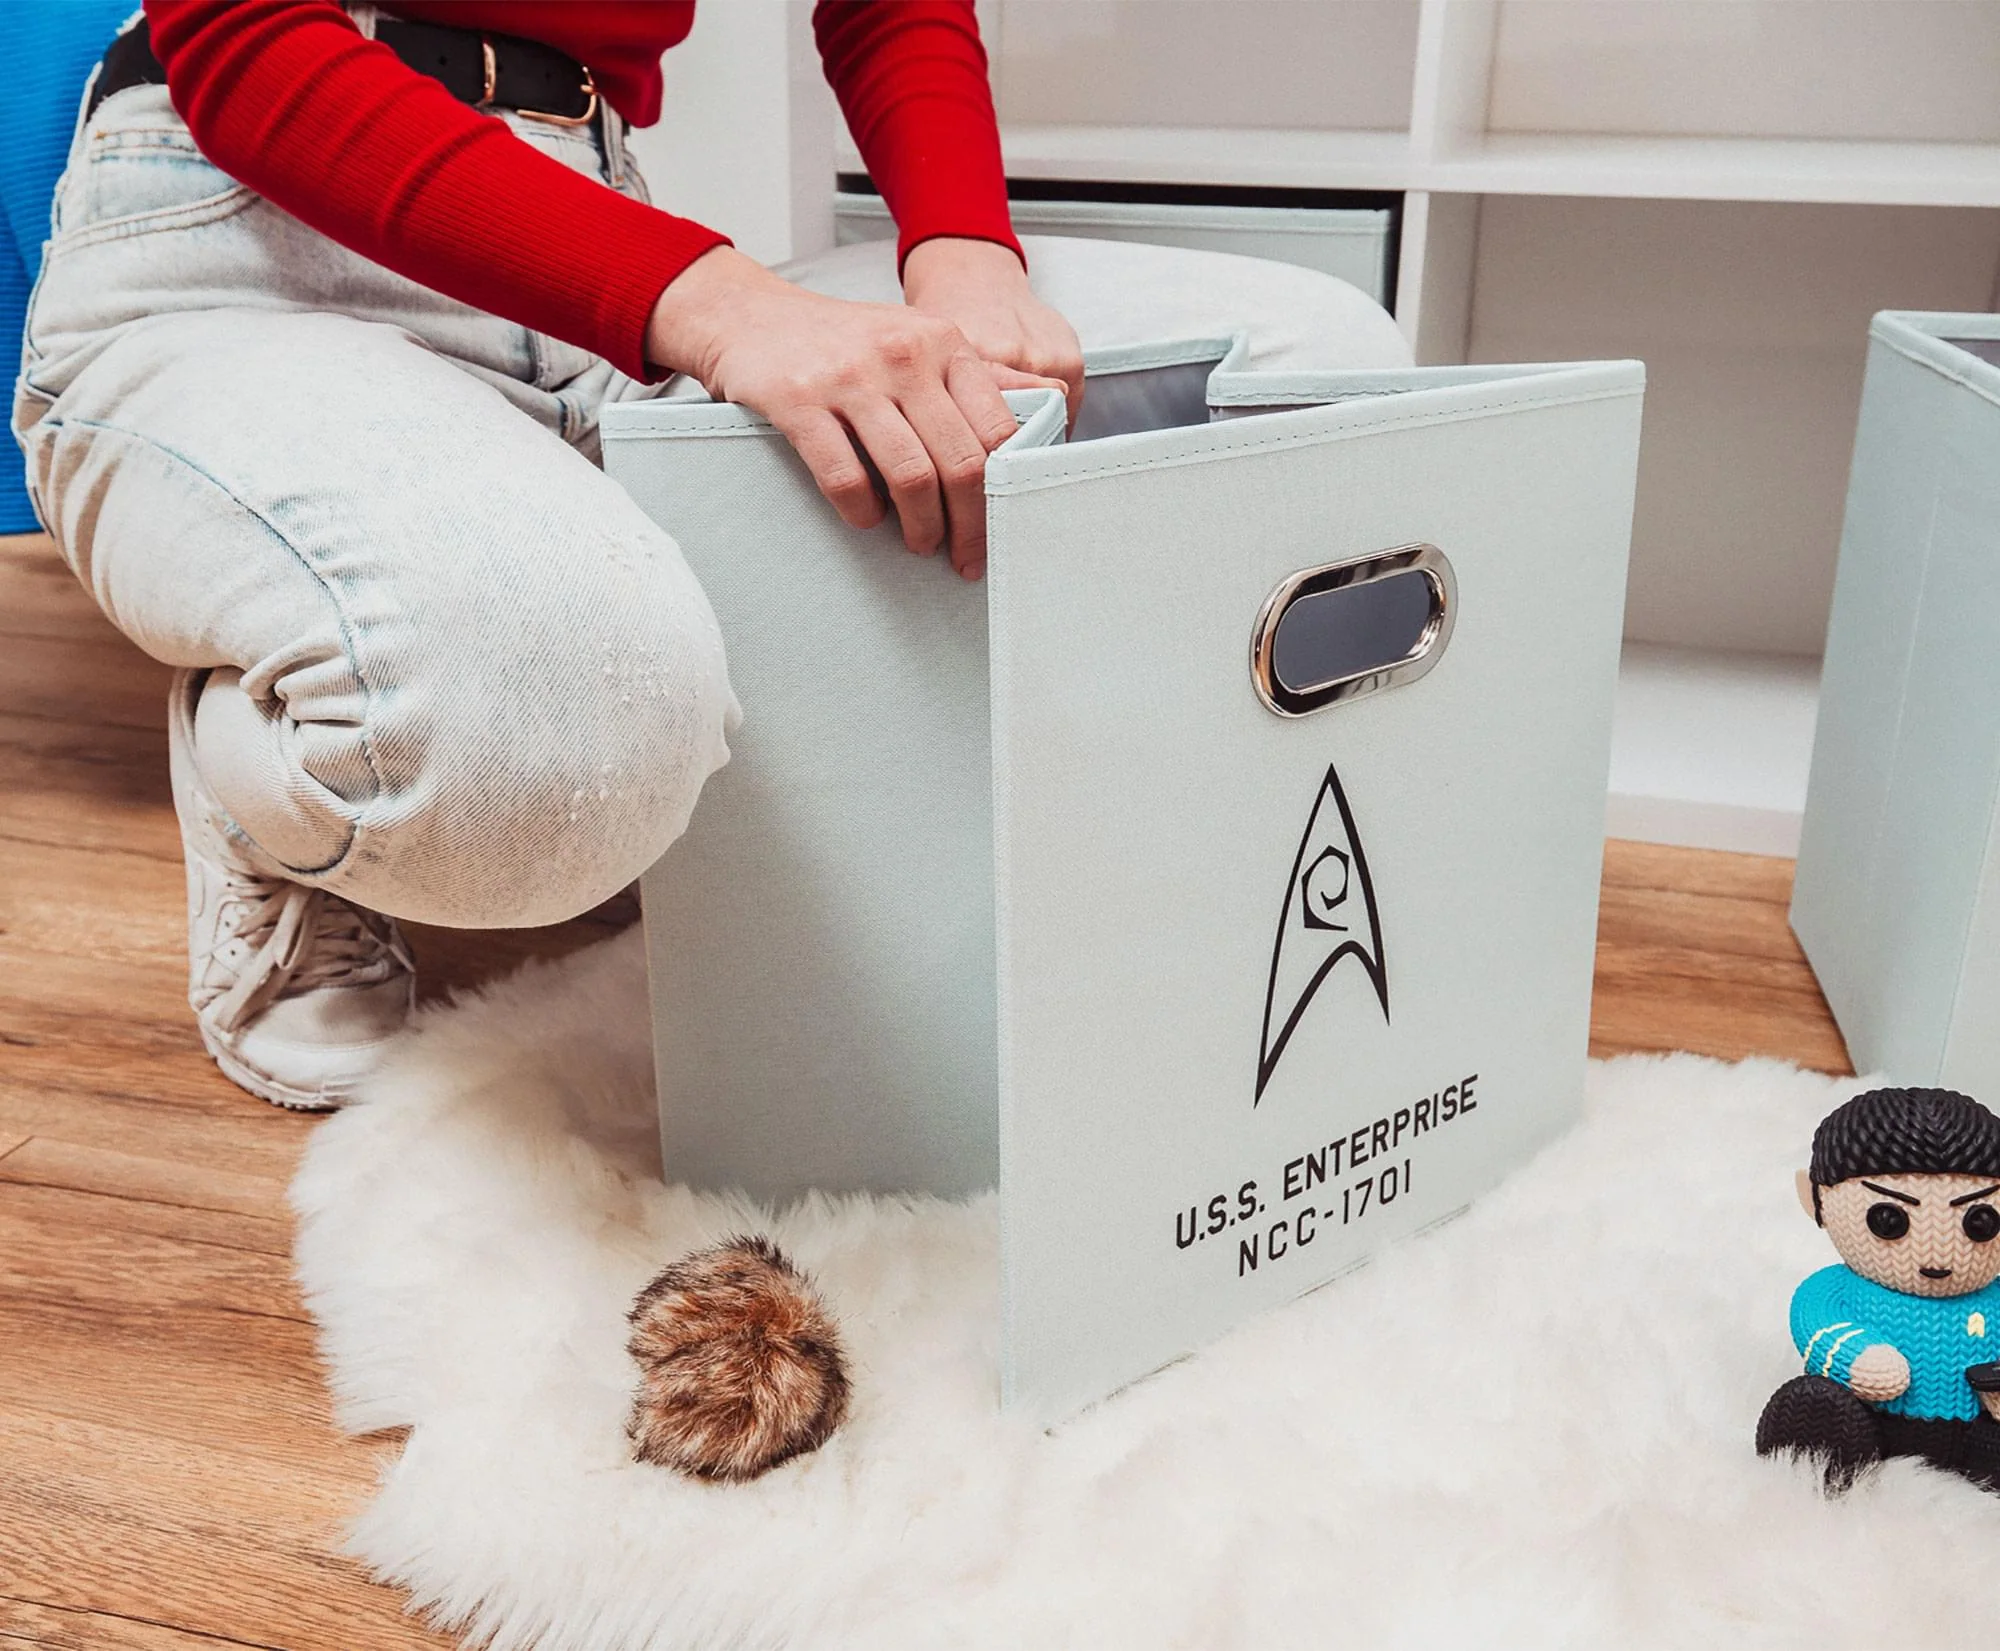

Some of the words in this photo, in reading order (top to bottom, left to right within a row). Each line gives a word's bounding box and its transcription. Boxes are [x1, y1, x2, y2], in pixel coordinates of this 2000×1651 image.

[1175, 1180, 1266, 1249] U.S.S.
[1283, 1073, 1479, 1201] ENTERPRISE
[1239, 1158, 1411, 1277] NCC-1701
